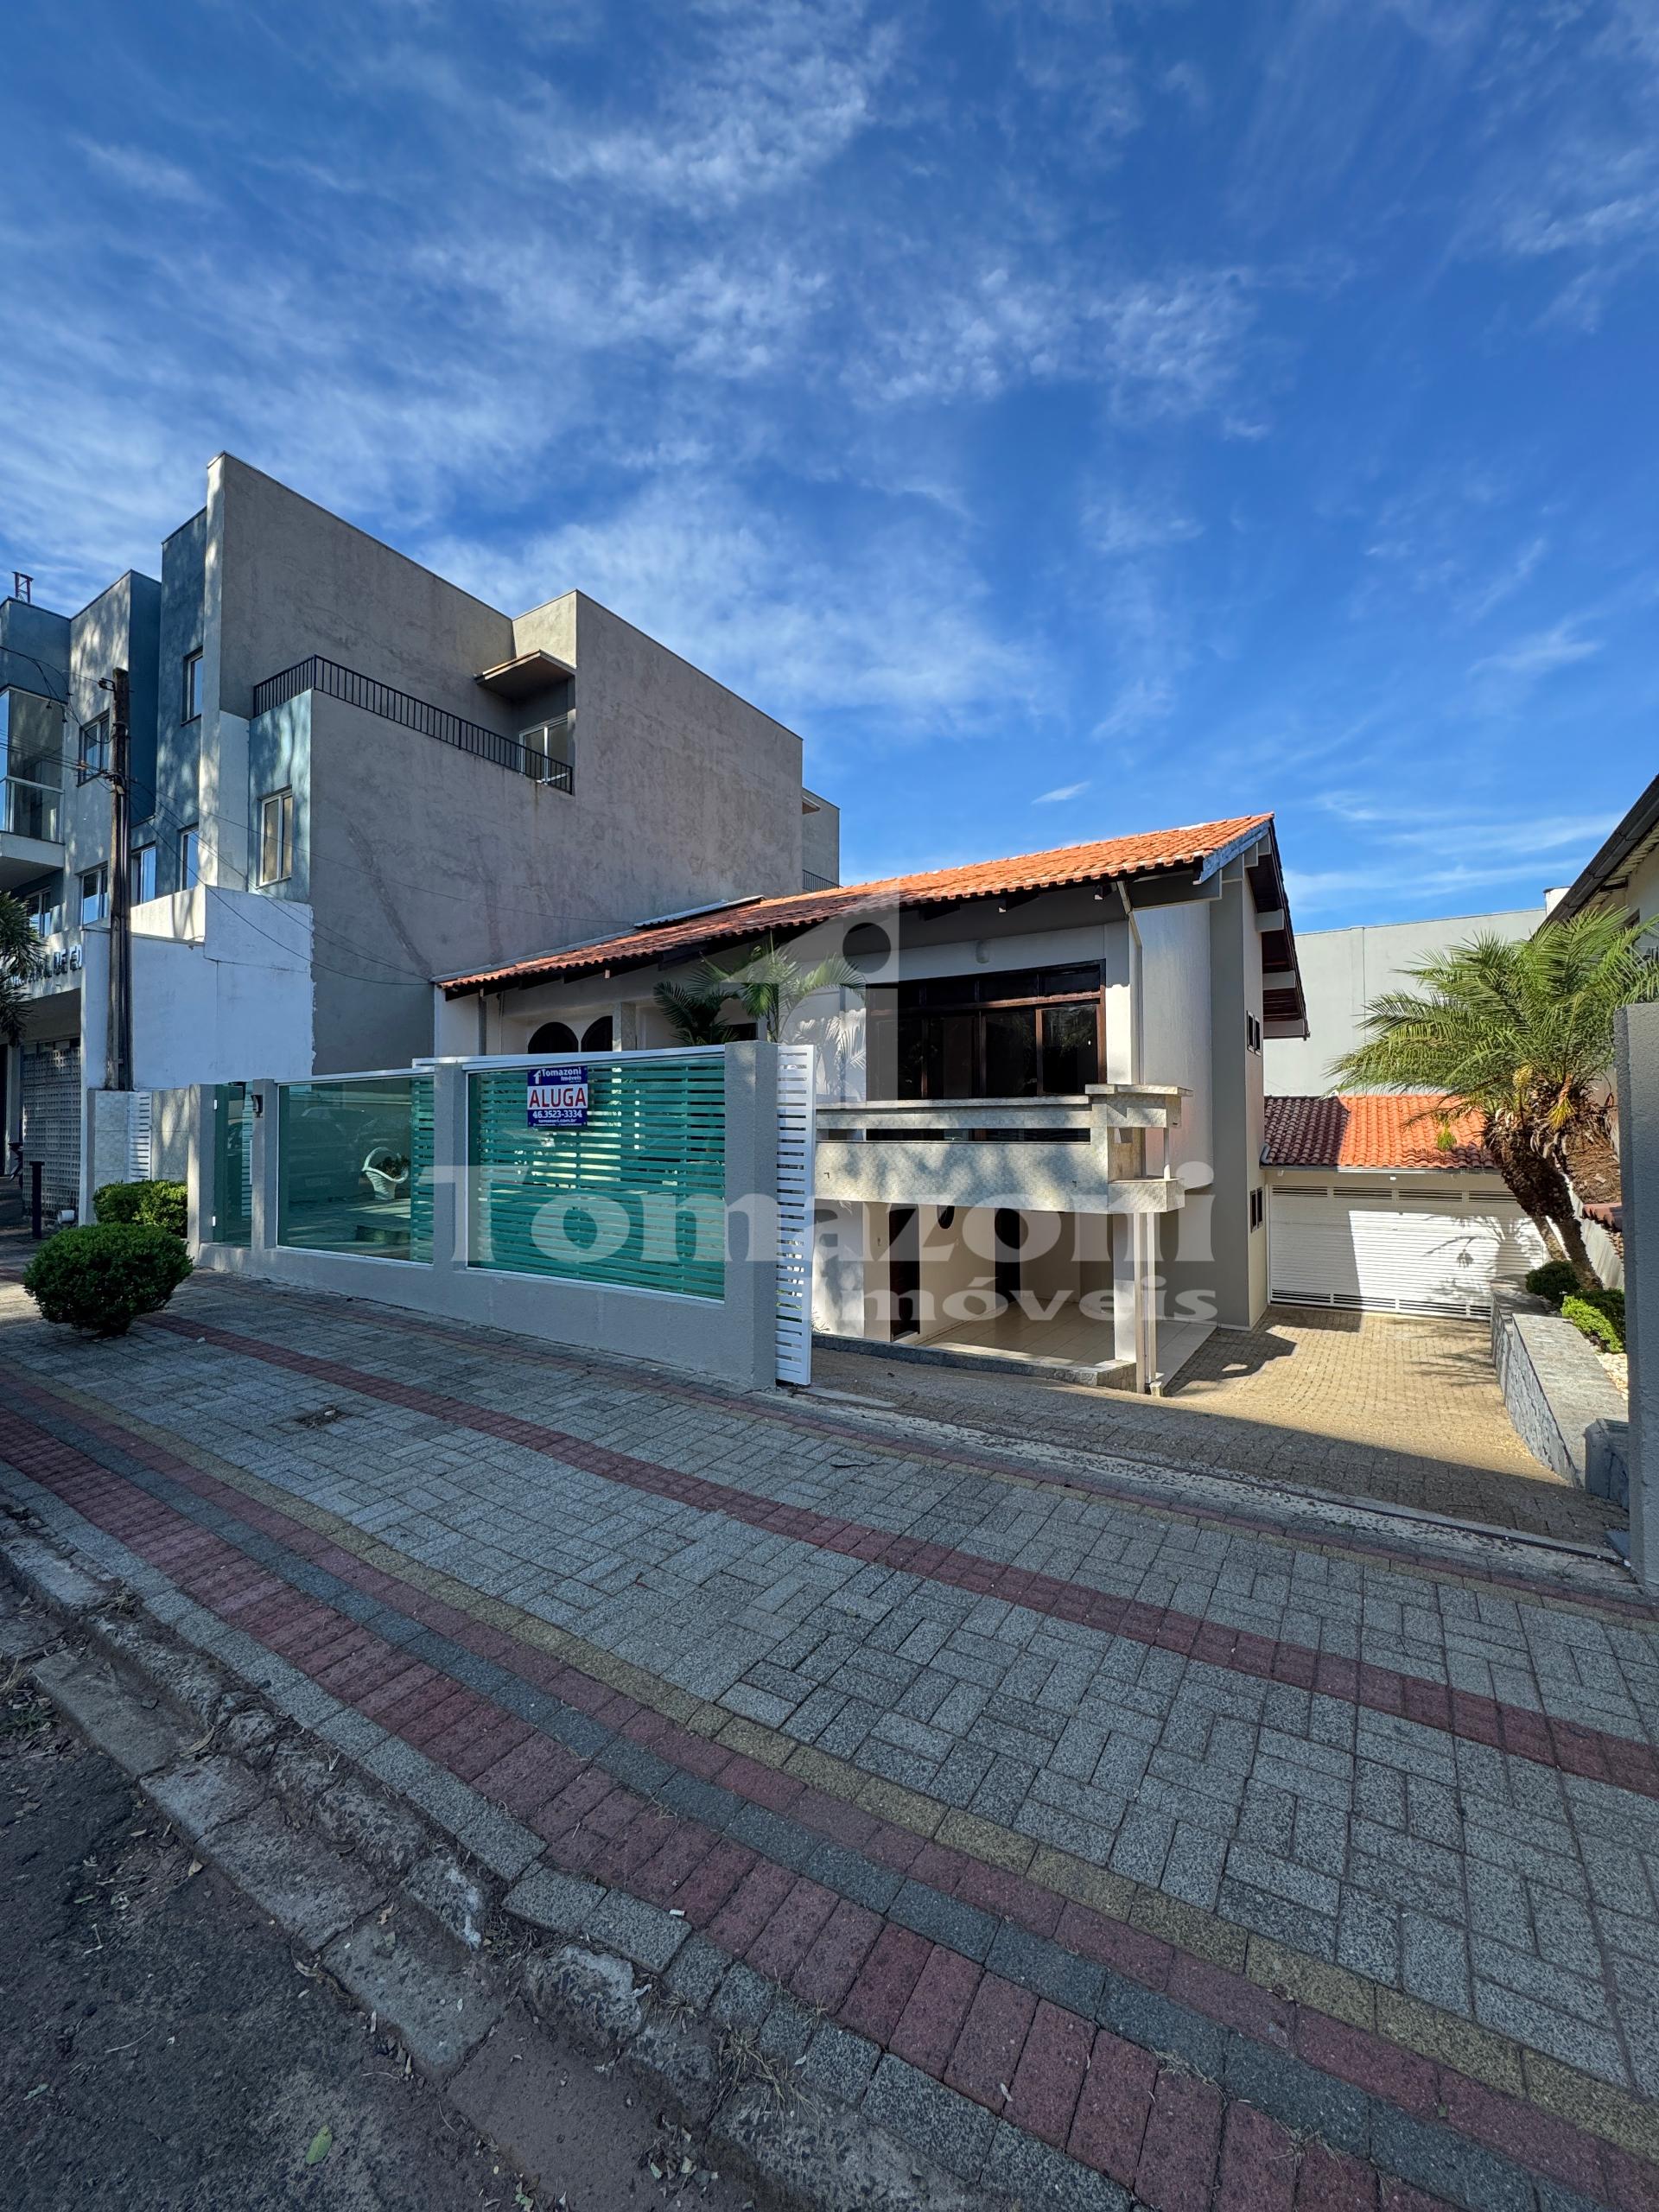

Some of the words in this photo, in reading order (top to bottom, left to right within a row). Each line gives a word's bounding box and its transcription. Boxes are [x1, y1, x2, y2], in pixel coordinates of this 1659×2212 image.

[541, 1067, 582, 1077] Tomazoni
[529, 1088, 586, 1108] ALUGA
[532, 1109, 582, 1119] 46.3523-3334
